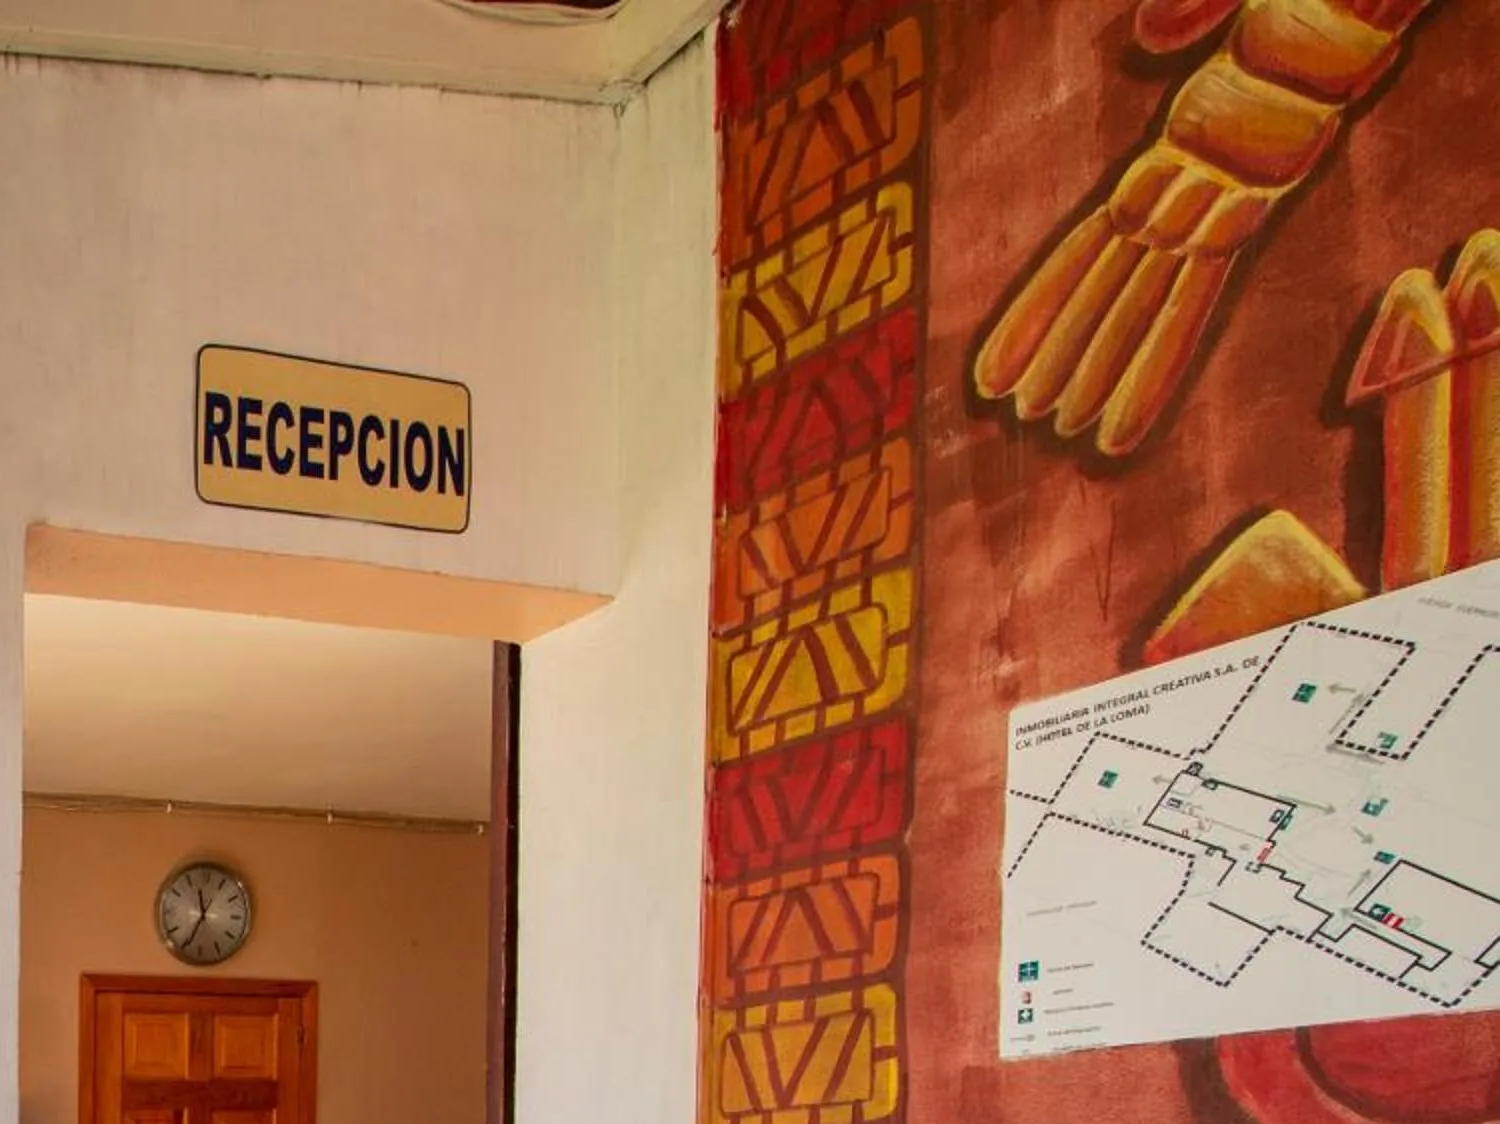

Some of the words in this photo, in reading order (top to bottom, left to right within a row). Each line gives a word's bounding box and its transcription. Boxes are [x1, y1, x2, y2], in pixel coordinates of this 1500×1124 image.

[203, 391, 465, 497] RECEPCION
[1015, 707, 1090, 737] INMOBILIARIA
[1093, 689, 1150, 713] INTEGRAL
[1153, 670, 1211, 695] CREATIVA
[1214, 664, 1238, 678] S.A.
[1243, 655, 1260, 669] DE
[1075, 721, 1091, 733] DE
[1094, 716, 1108, 727] LA
[1110, 703, 1151, 723] LOMA)
